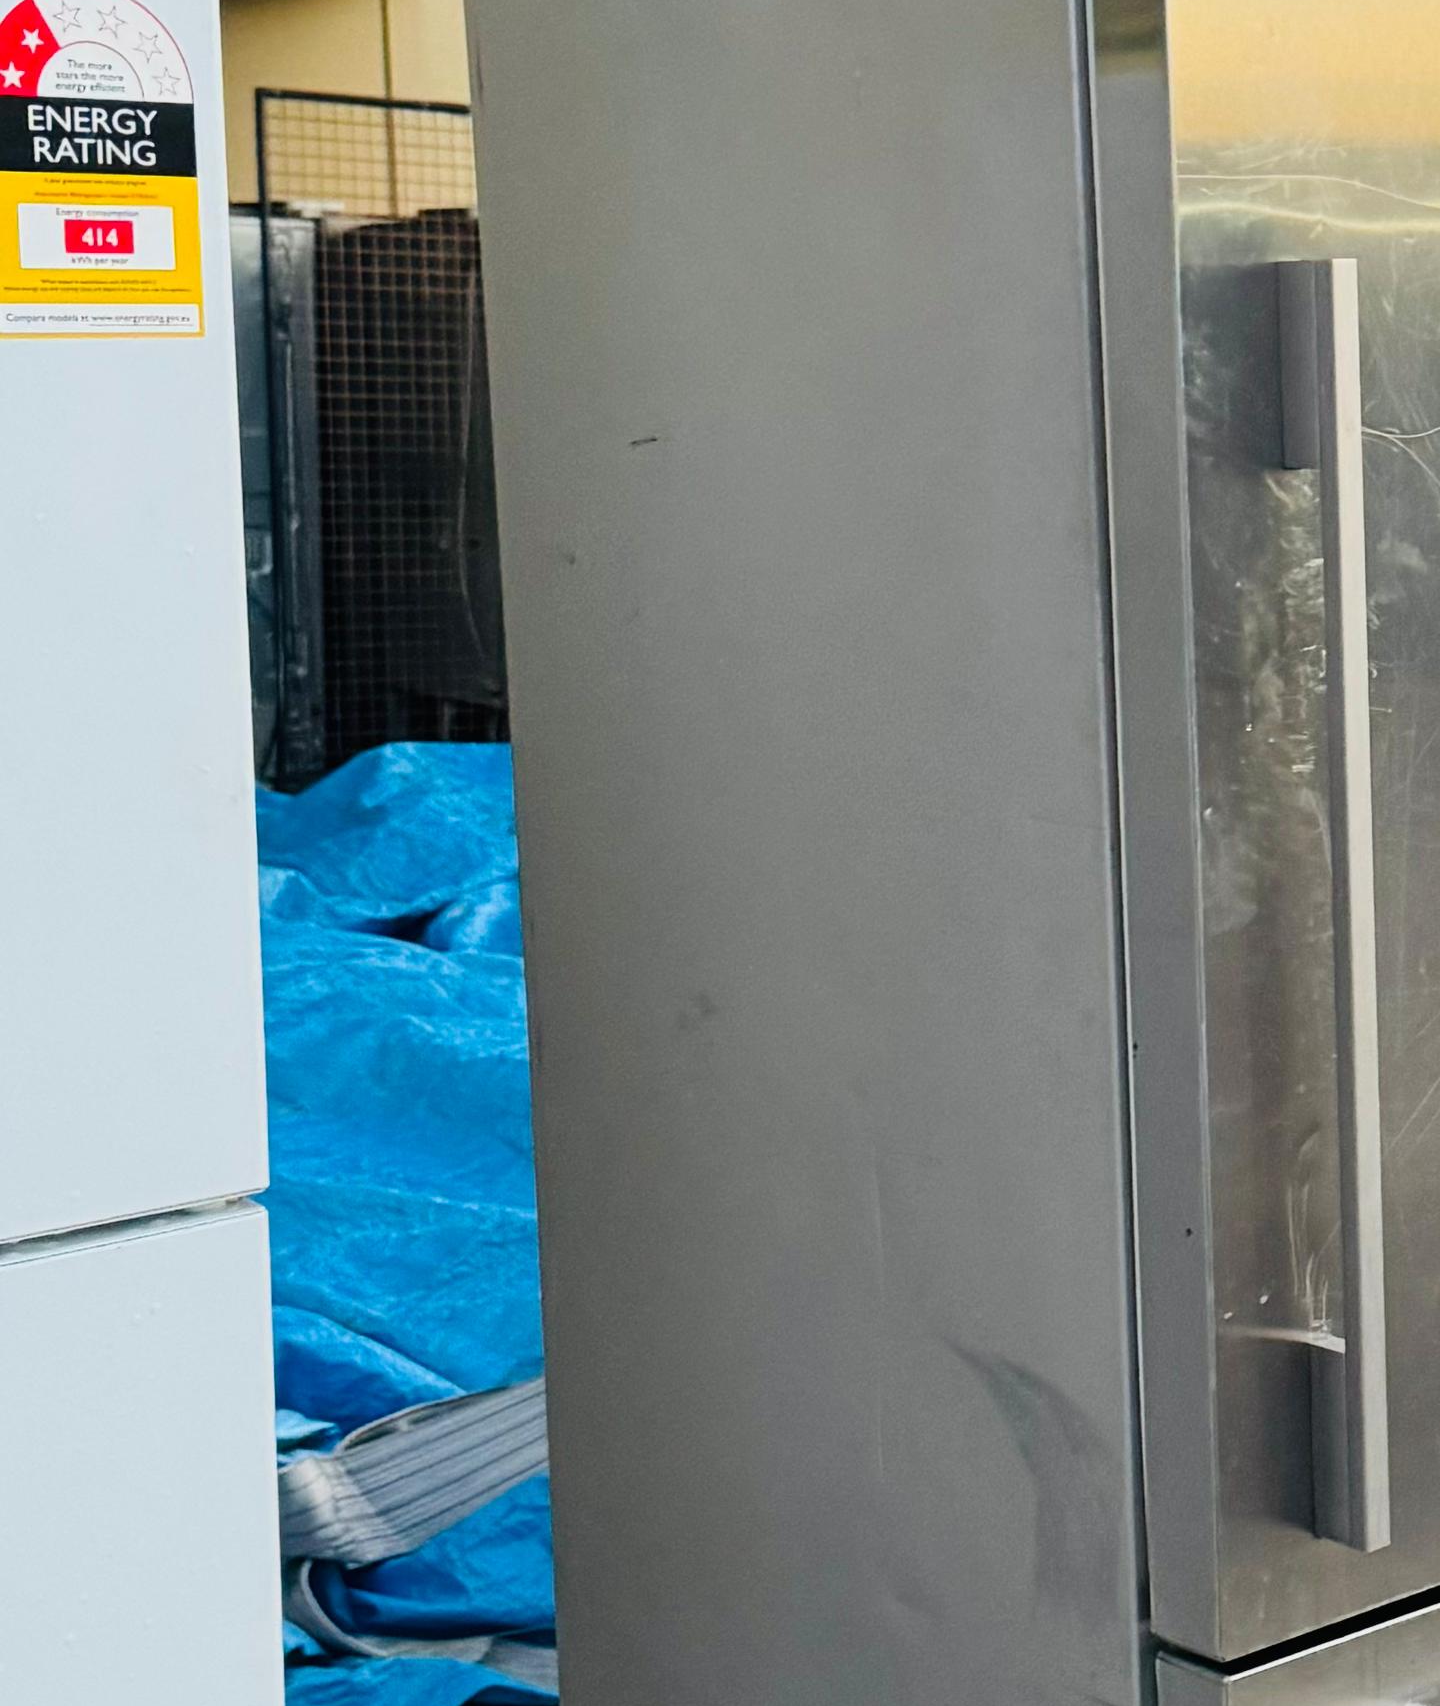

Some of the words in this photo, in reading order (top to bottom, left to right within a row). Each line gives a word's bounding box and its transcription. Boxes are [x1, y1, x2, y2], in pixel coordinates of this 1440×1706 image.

[27, 104, 158, 136] ENERGY
[33, 136, 157, 166] RATING
[81, 227, 119, 247] 414
